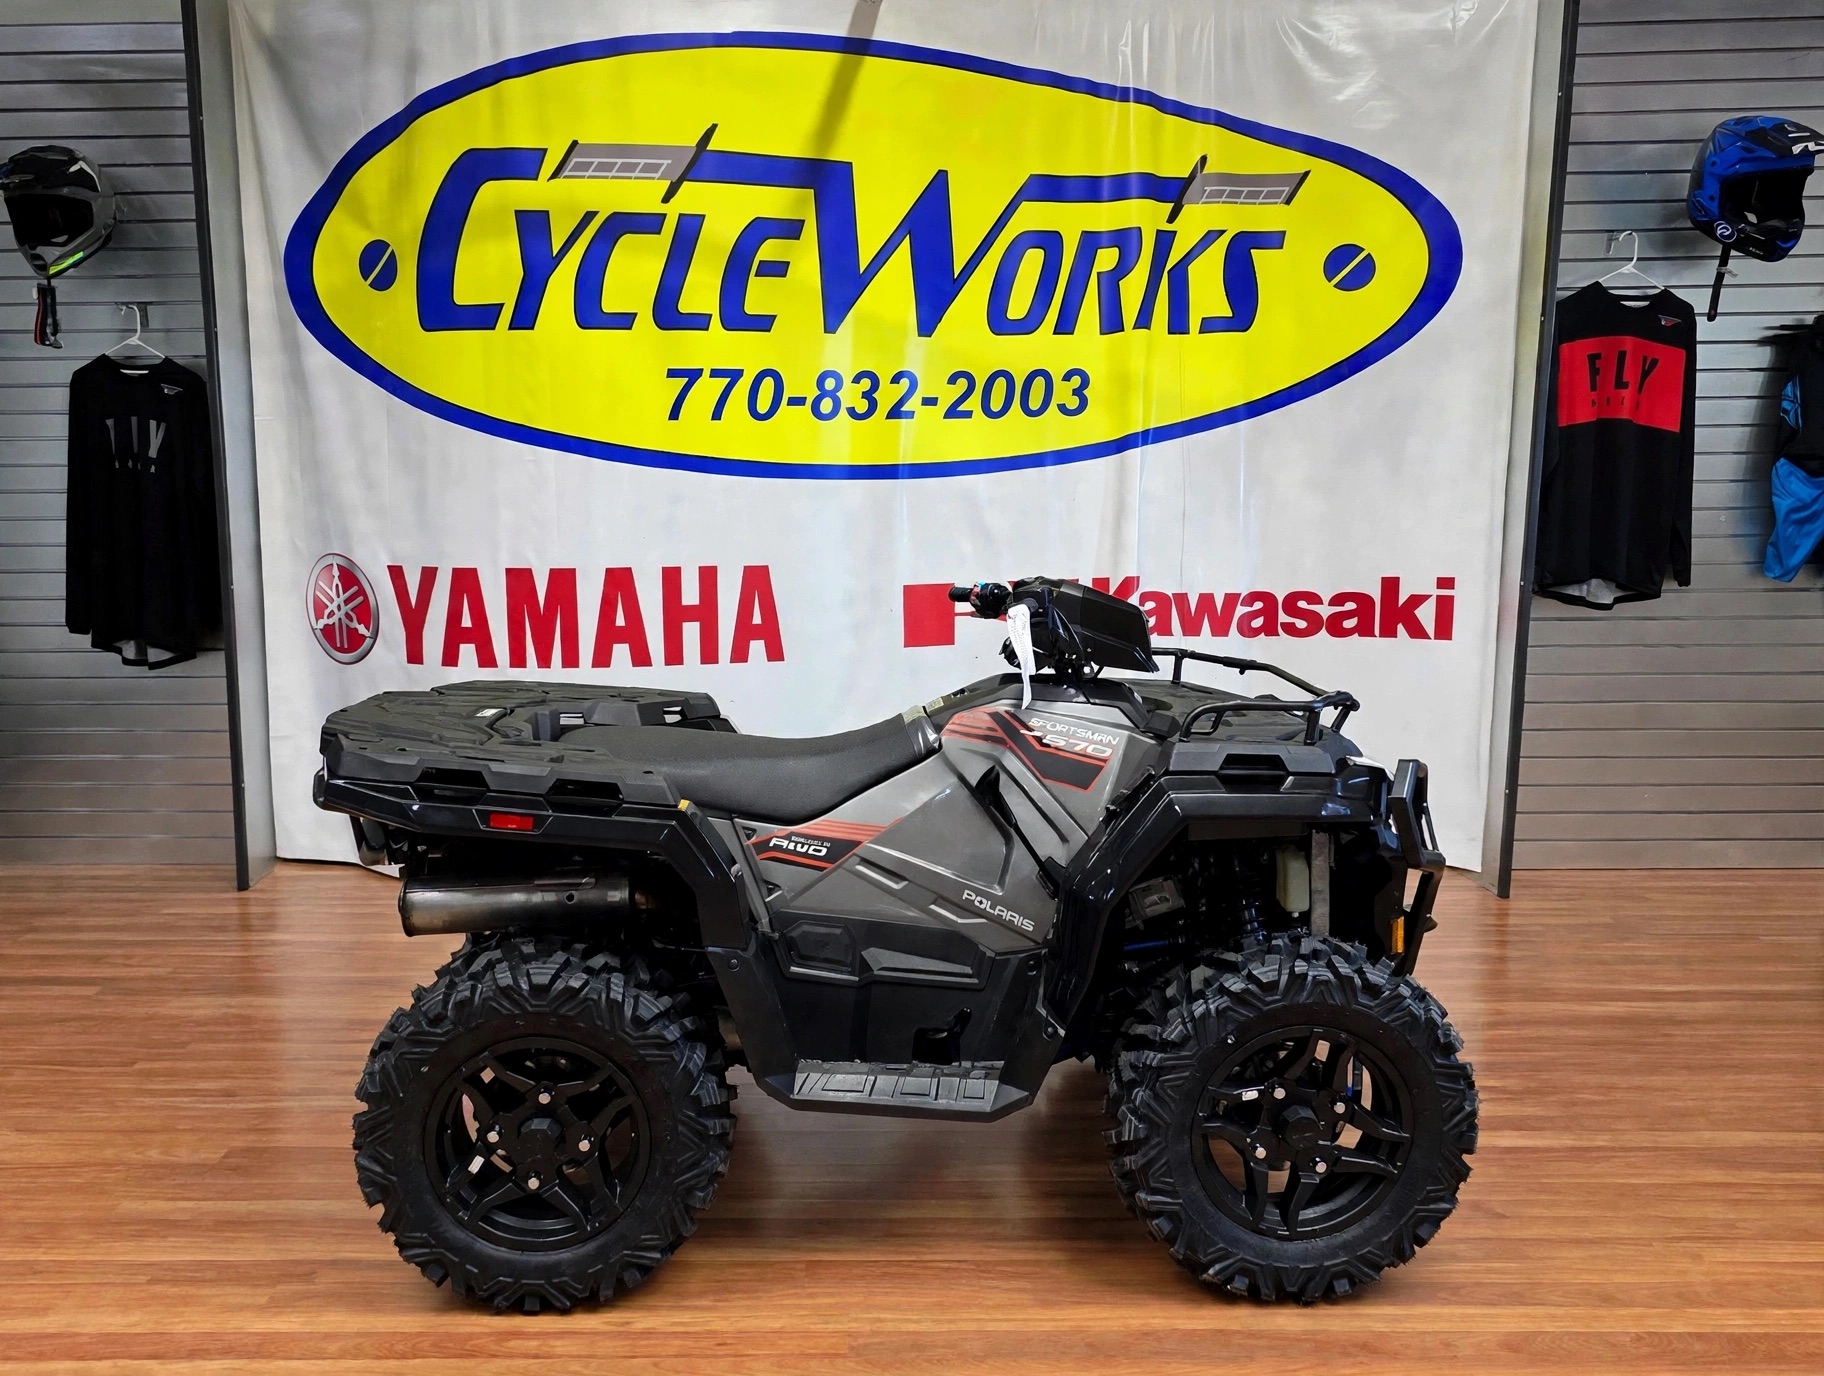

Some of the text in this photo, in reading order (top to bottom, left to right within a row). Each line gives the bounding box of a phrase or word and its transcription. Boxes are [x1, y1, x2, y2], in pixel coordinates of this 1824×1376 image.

[665, 367, 1091, 422] 770-832-2003
[1586, 350, 1660, 395] FLY
[387, 565, 785, 669] YAMAHA
[962, 889, 1035, 932] POLARIS
